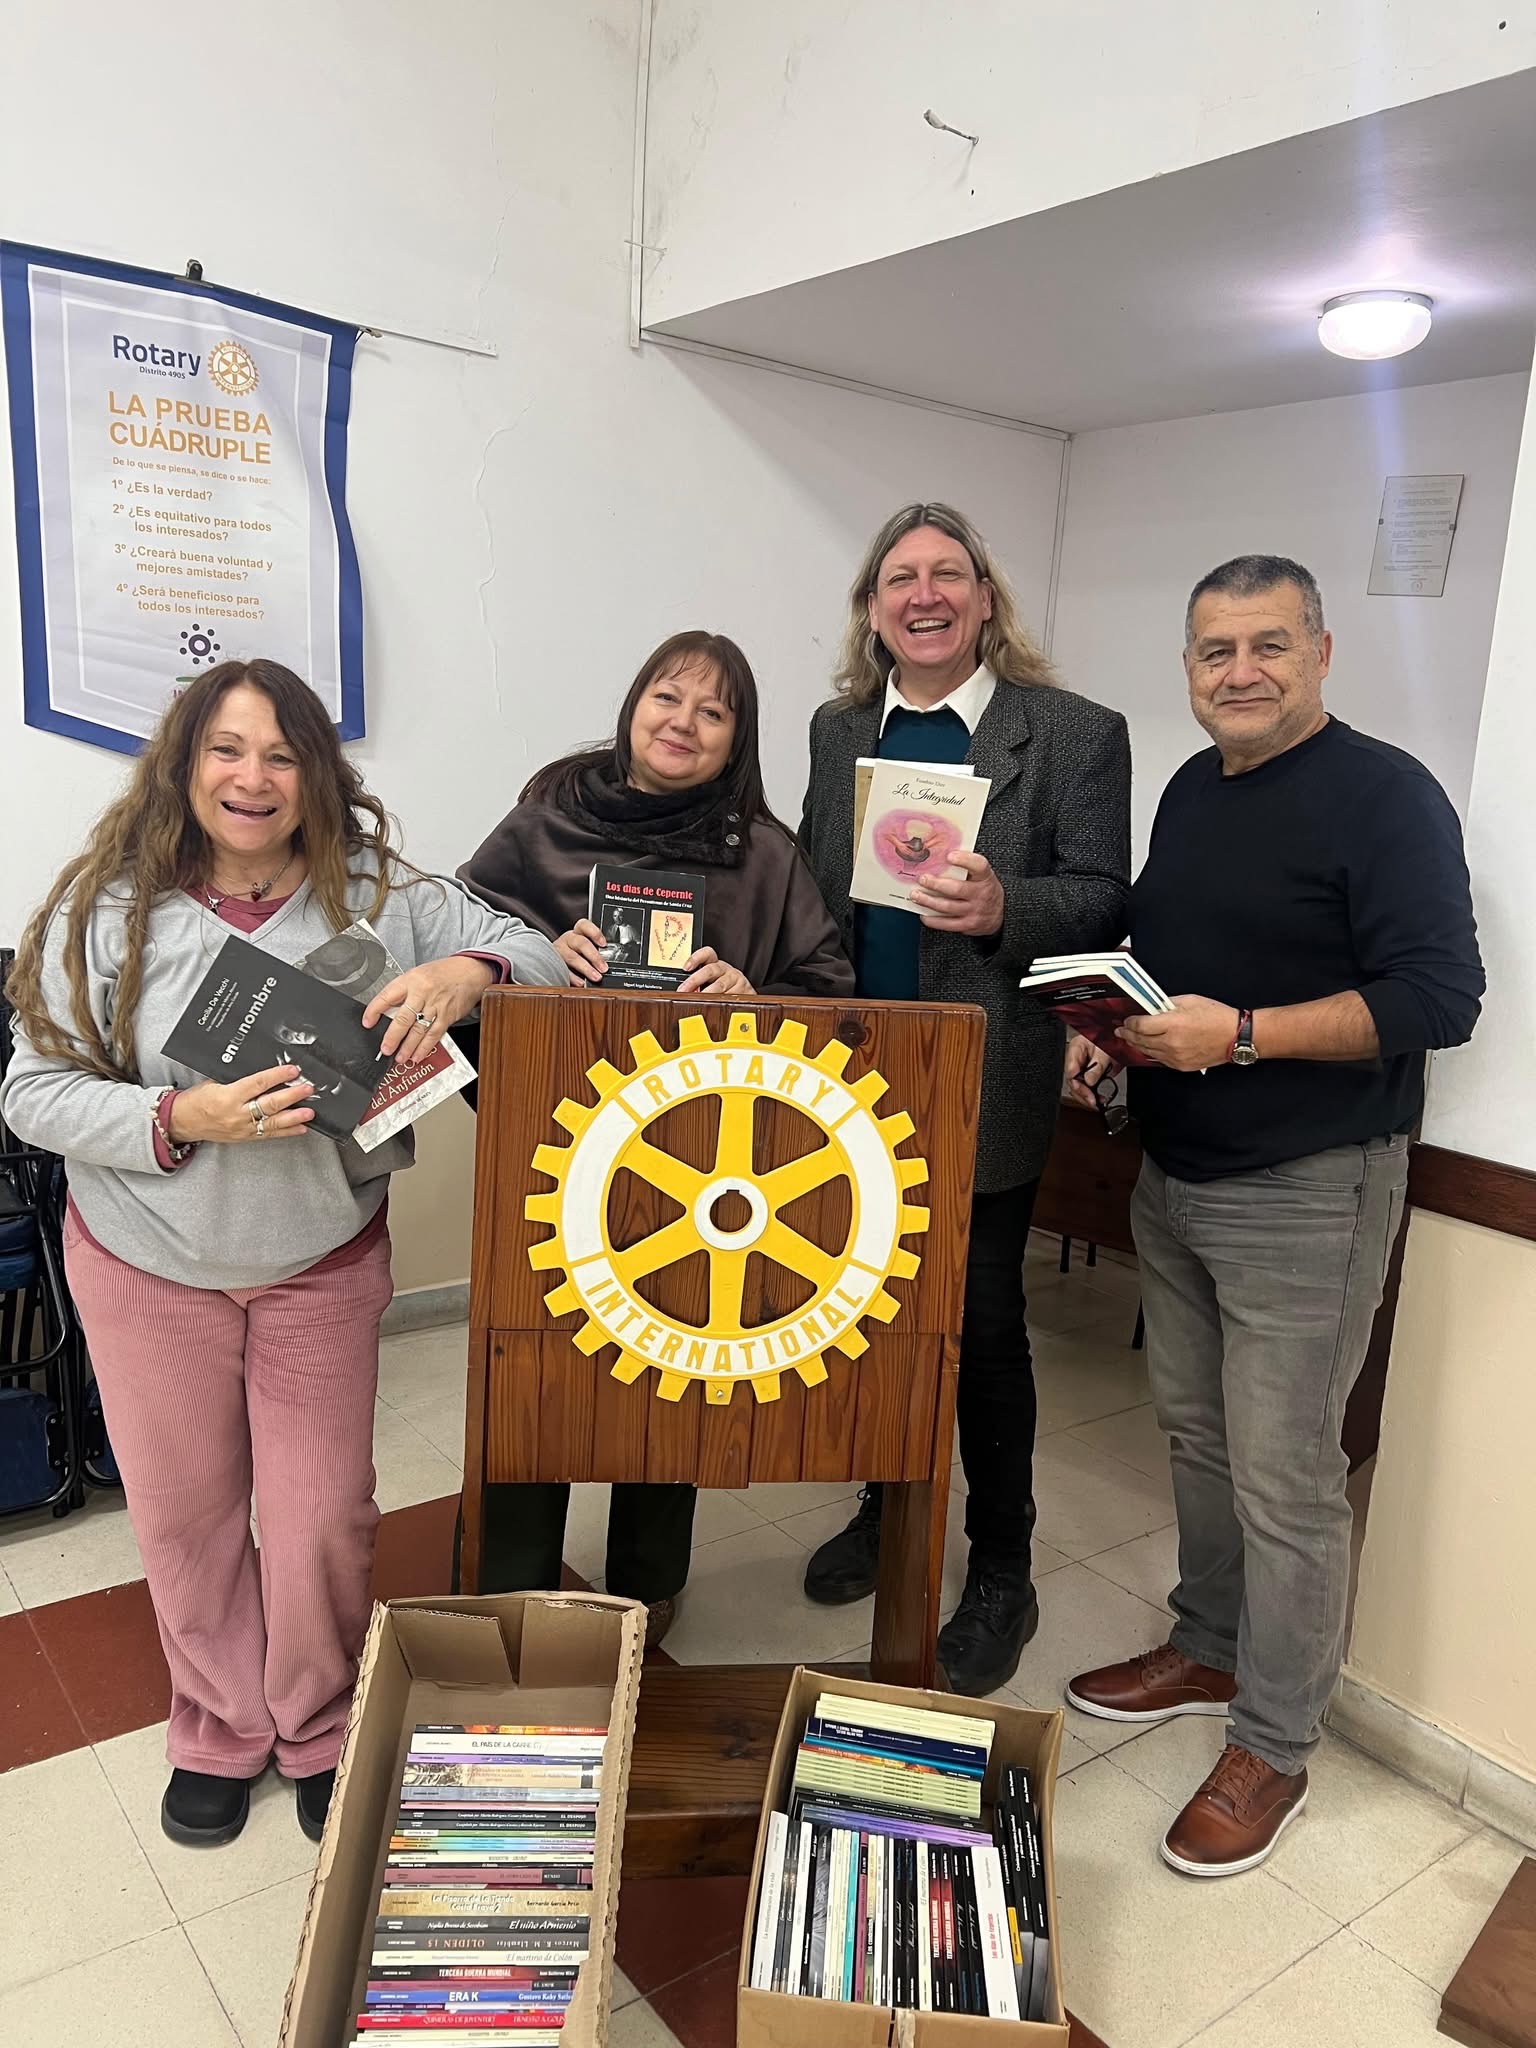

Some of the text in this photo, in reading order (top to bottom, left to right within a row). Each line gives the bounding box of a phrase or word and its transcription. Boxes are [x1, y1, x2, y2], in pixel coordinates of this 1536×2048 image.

[113, 335, 201, 377] Rotary
[139, 366, 186, 379] Distrito 4905
[108, 391, 272, 436] LA PRUEBA
[109, 421, 271, 464] CUÁDRUPLE
[112, 457, 124, 467] De
[126, 458, 135, 467] lo
[138, 461, 154, 472] que
[156, 463, 166, 472] se
[168, 463, 199, 478] piensa,
[200, 469, 210, 478] se
[211, 470, 228, 481] dice
[237, 474, 247, 483] se
[249, 475, 271, 485] hace:
[127, 482, 150, 494] ¿Es
[153, 483, 164, 494] la
[167, 486, 212, 501] verdad?
[128, 506, 150, 518] ¿Es
[154, 509, 211, 525] equitativo
[214, 517, 237, 529] para
[240, 520, 272, 532] todos
[135, 521, 229, 541] los interesados?
[130, 546, 176, 561] ¿Creará
[180, 550, 214, 564] buena
[217, 555, 264, 569] voluntad
[266, 560, 273, 571] y
[136, 562, 249, 582] mejores amistades?
[131, 585, 166, 598] ¿Será
[169, 588, 233, 603] beneficioso
[236, 595, 260, 606] para
[138, 601, 265, 620] todos los interesados?
[892, 783, 967, 806] La Integridad
[606, 881, 621, 892] Los
[643, 887, 654, 896] de
[656, 888, 693, 900] Cepernic
[213, 977, 230, 998] Vecchi
[208, 996, 219, 1007] De
[197, 1005, 214, 1026] Cecilia
[371, 1091, 388, 1110] del
[388, 1063, 435, 1098] Anfitrión
[642, 1053, 836, 1109] ROTARY
[586, 1277, 864, 1372] INTERNATIONAL
[509, 1920, 520, 1929] El
[540, 1920, 576, 1930] Armenio
[444, 1939, 485, 1948] OLIDEN
[506, 1953, 515, 1961] El
[544, 1952, 552, 1960] de
[449, 1991, 479, 2002] ERA K
[518, 1993, 541, 2001] Gustavo
